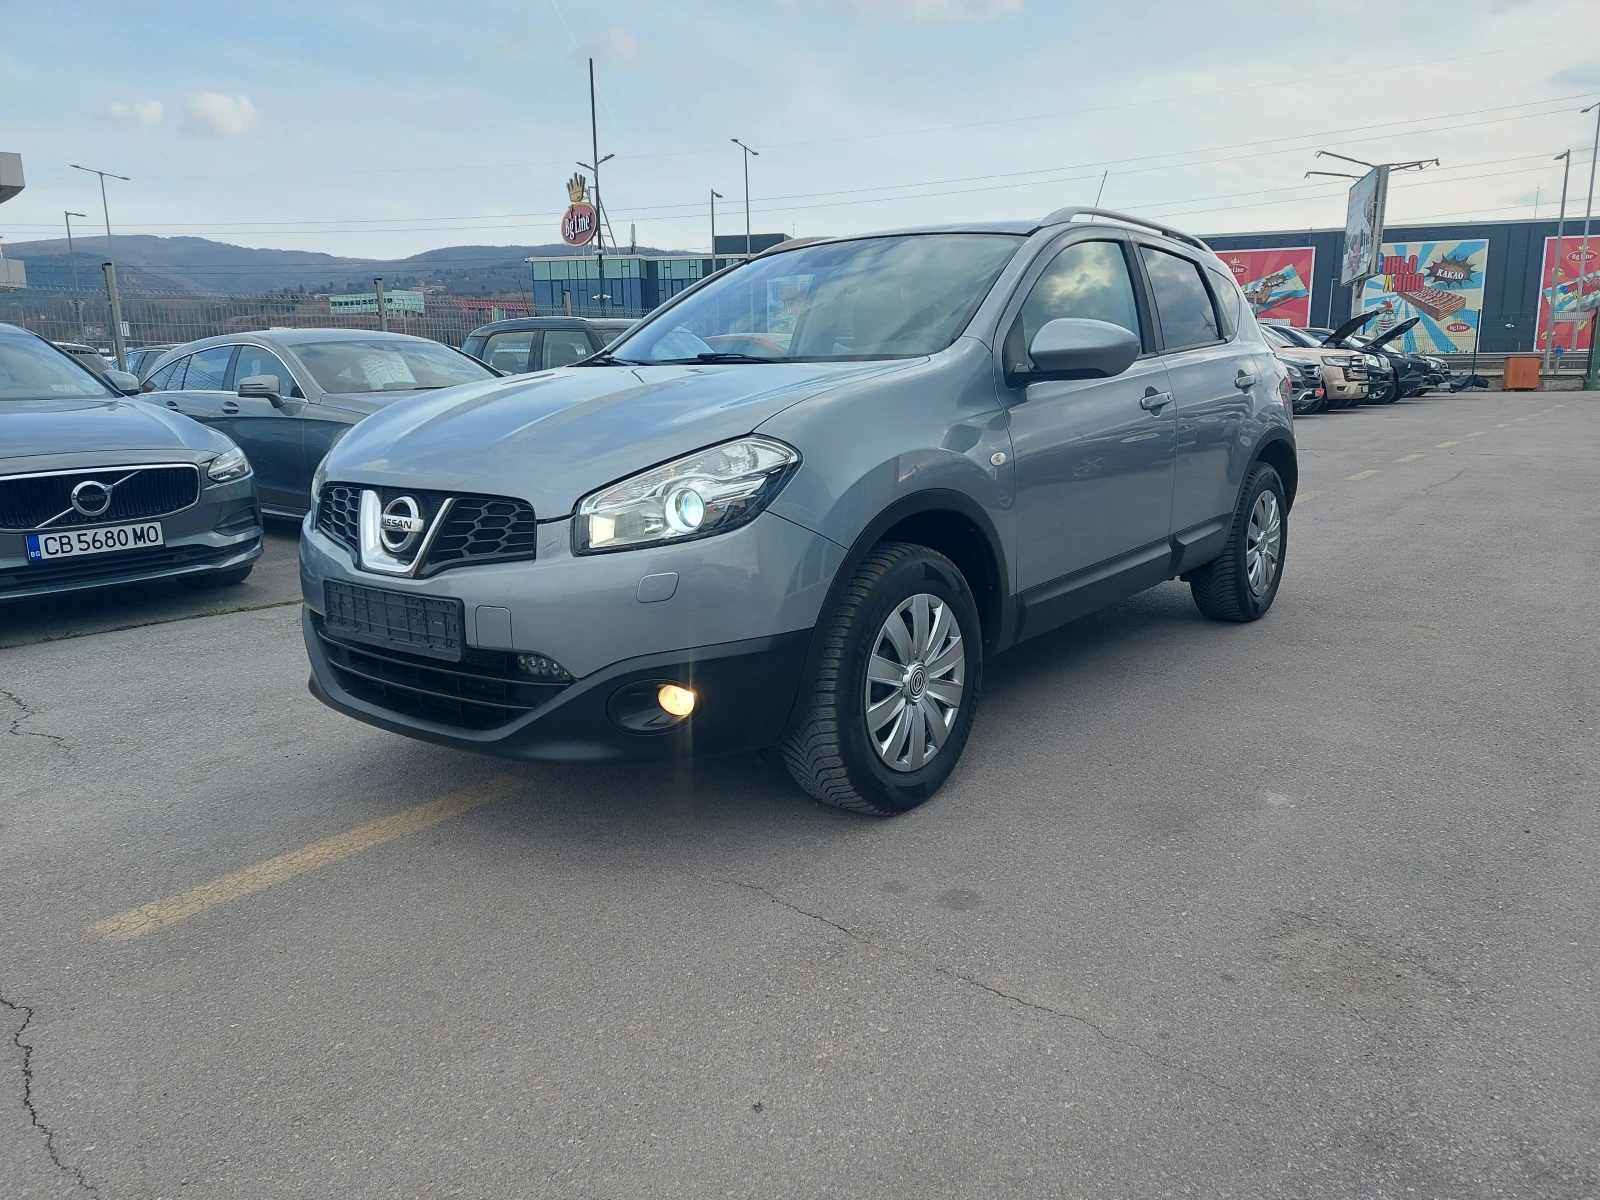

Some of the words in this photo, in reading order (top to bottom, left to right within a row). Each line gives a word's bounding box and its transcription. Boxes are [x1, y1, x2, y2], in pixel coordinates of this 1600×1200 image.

[574, 213, 590, 234] Line
[1436, 268, 1464, 280] КАКАО
[43, 535, 74, 556] CB
[76, 529, 129, 552] 5680
[131, 525, 159, 546] MO
